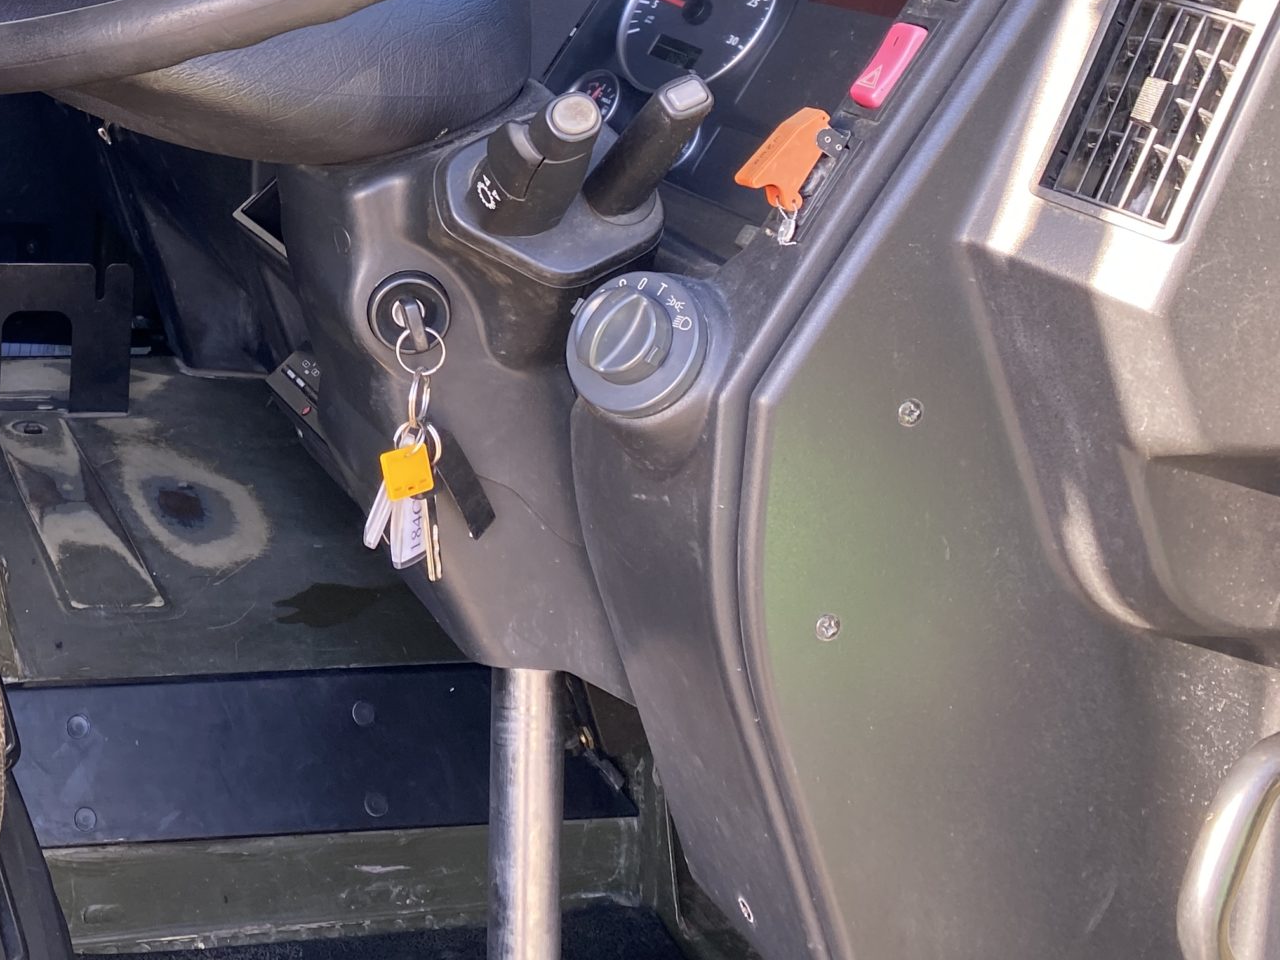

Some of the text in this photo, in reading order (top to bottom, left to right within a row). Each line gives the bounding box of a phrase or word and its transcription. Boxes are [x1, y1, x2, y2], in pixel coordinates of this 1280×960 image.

[651, 0, 660, 9] 5
[726, 34, 739, 46] 30
[657, 282, 668, 296] T
